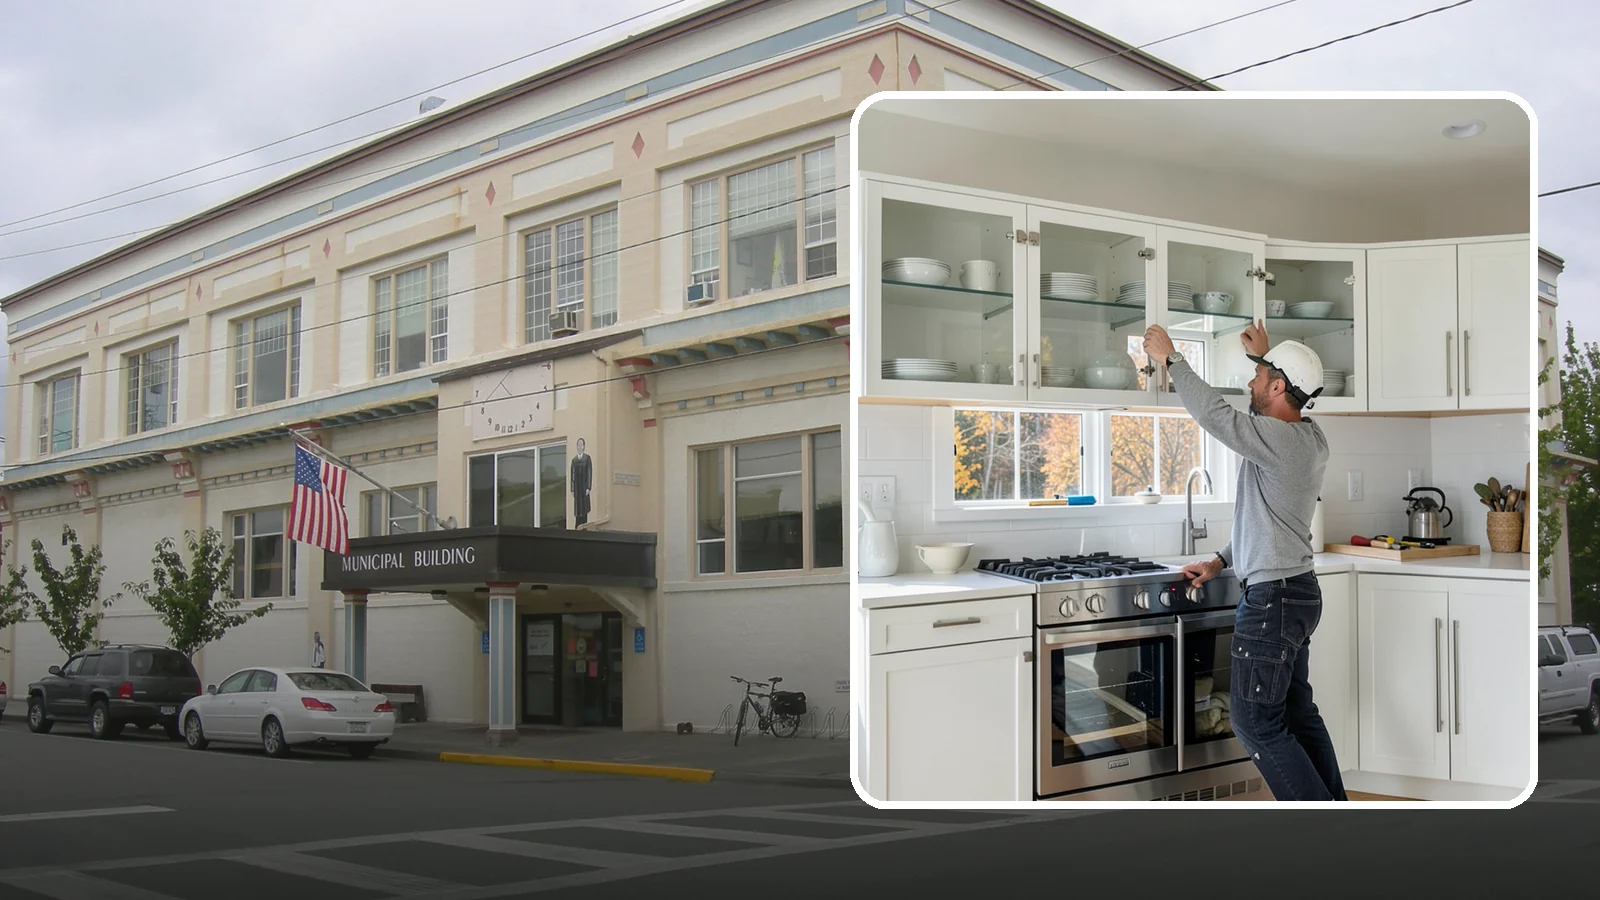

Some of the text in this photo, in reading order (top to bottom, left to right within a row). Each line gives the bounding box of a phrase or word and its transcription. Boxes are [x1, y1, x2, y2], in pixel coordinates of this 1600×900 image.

[536, 402, 540, 410] 4
[480, 407, 485, 415] 8
[488, 417, 492, 426] 9
[521, 420, 525, 428] 2
[494, 423, 500, 432] 10
[507, 425, 513, 433] 12
[342, 546, 475, 572] MUNICIPAL BUILDING
